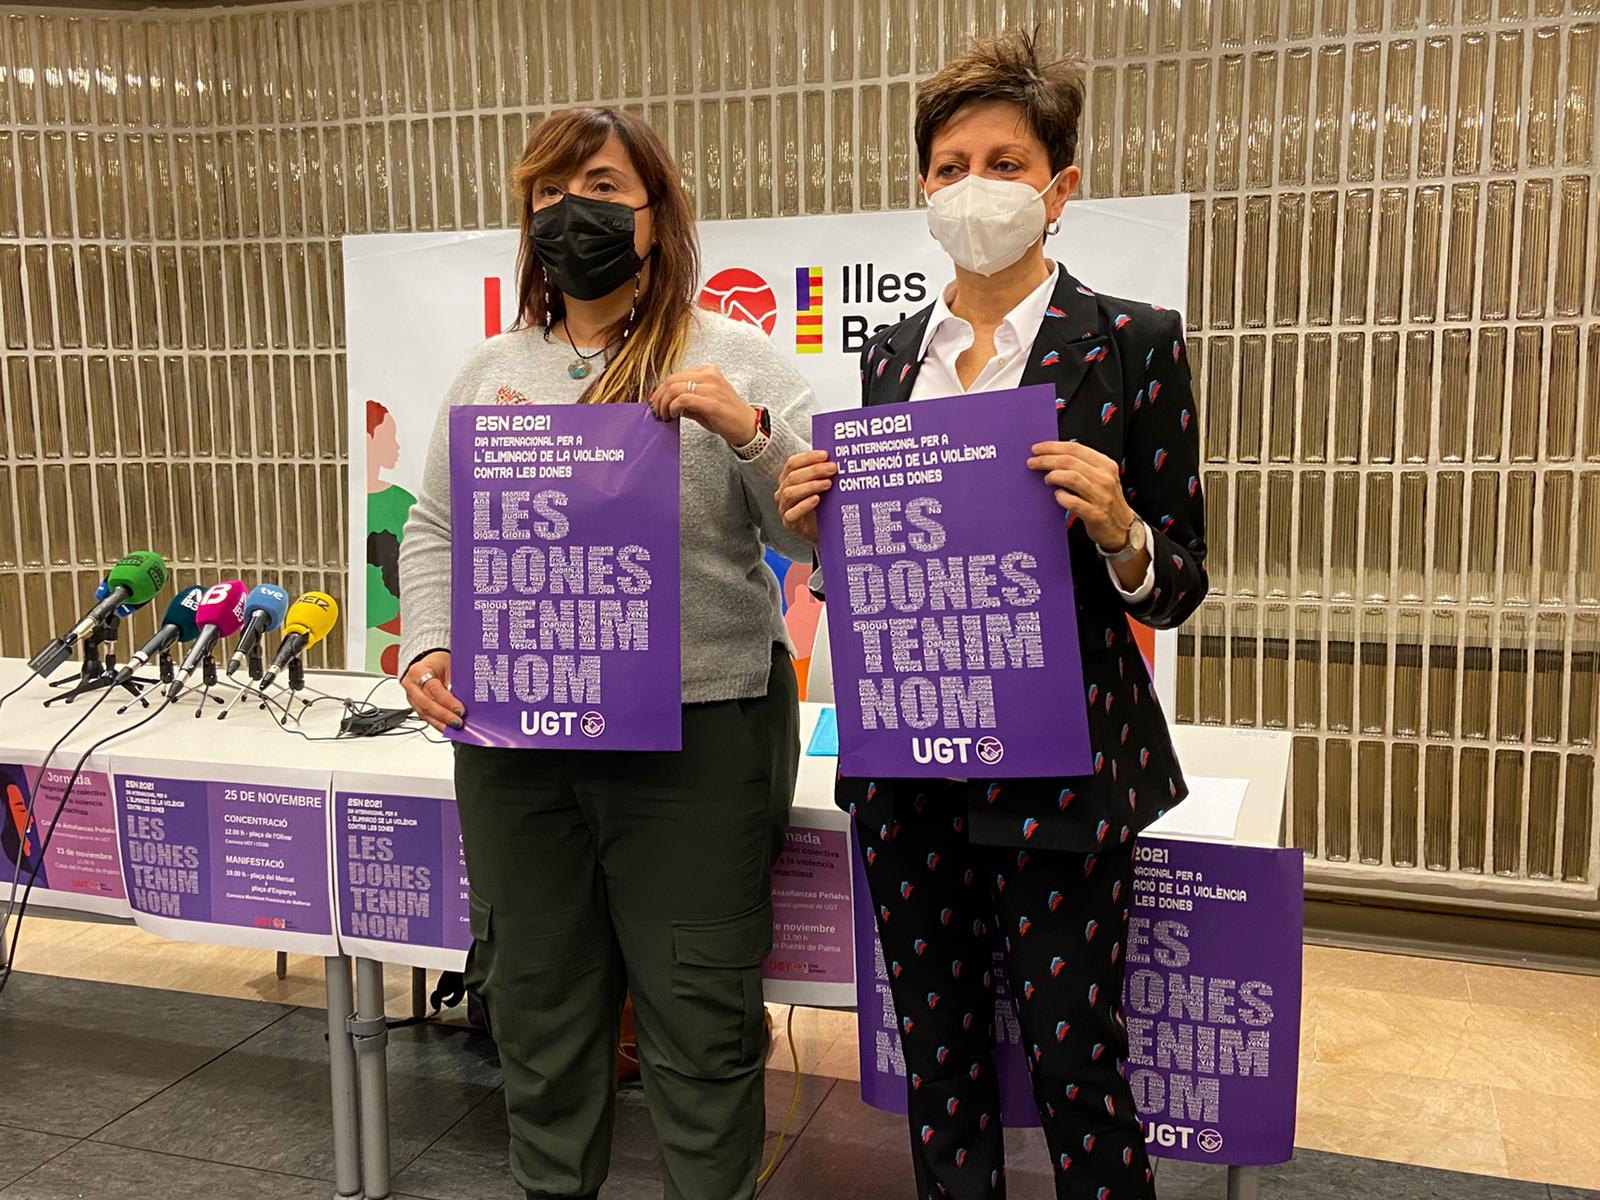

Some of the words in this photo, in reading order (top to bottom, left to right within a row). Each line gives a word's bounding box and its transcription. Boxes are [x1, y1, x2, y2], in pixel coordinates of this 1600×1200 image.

[842, 263, 926, 303] Illes
[475, 416, 509, 431] 25N
[512, 415, 551, 431] 2021
[834, 419, 869, 440] 25N
[870, 414, 912, 436] 2021
[474, 437, 488, 447] DIA
[491, 436, 554, 447] INTERNACIONAL
[557, 436, 574, 446] PER
[576, 435, 583, 445] A
[835, 445, 850, 457] DIA
[852, 437, 919, 455] INTERNACIONAL
[921, 435, 939, 448] PER
[941, 434, 949, 445] A
[540, 451, 553, 462] DE
[557, 450, 570, 462] LA
[573, 446, 624, 461] VIOLÈNCIA
[905, 453, 920, 468] DE
[923, 451, 938, 466] LA
[940, 444, 997, 464] VIOLÈNCIA
[474, 467, 513, 478] CONTRA
[516, 466, 536, 478] LES
[539, 466, 572, 478] DONES
[839, 476, 880, 492] CONTRA
[882, 472, 904, 488] LES
[907, 469, 943, 485] DONES
[473, 490, 570, 540] LES
[841, 496, 947, 558] LES
[473, 545, 652, 595] DONES
[260, 587, 284, 601] tve
[847, 551, 1041, 615] DONES
[474, 601, 507, 609] Saloua
[474, 600, 648, 651] TENIM
[853, 621, 888, 631] Saloua
[853, 611, 1045, 673] TENIM
[474, 654, 601, 704] NOM
[858, 675, 997, 730] NOM
[520, 711, 577, 736] UGT
[911, 737, 972, 764] UGT
[47, 772, 91, 786] Jornda
[224, 789, 237, 801] 25
[240, 791, 255, 802] DE
[258, 792, 322, 808] NOVEMBRE
[127, 814, 165, 841] LES
[224, 814, 288, 828] CONCENTRACIÓ
[225, 828, 239, 836] 12.00
[249, 831, 265, 839] plaça
[128, 840, 199, 869] DONES
[348, 835, 394, 862] LES
[802, 847, 840, 858] colectiva
[225, 855, 285, 869] MANIFESTACIÓ
[786, 857, 794, 865] la
[796, 859, 834, 869] violencia
[131, 863, 199, 895] TENIM
[250, 872, 265, 881] plaça
[265, 873, 274, 881] del
[349, 862, 431, 891] DONES
[1175, 870, 1193, 881] PER
[1196, 872, 1202, 882] A
[134, 887, 181, 917] NOM
[350, 886, 430, 918] TENIM
[1135, 895, 1155, 907] LES
[1159, 897, 1193, 911] DONES
[1159, 882, 1173, 894] DE
[1176, 884, 1190, 896] LA
[1194, 884, 1247, 902] VIOLÈNCIA
[351, 912, 409, 941] NOM
[783, 923, 836, 933] noviembre
[818, 944, 841, 953] Palma
